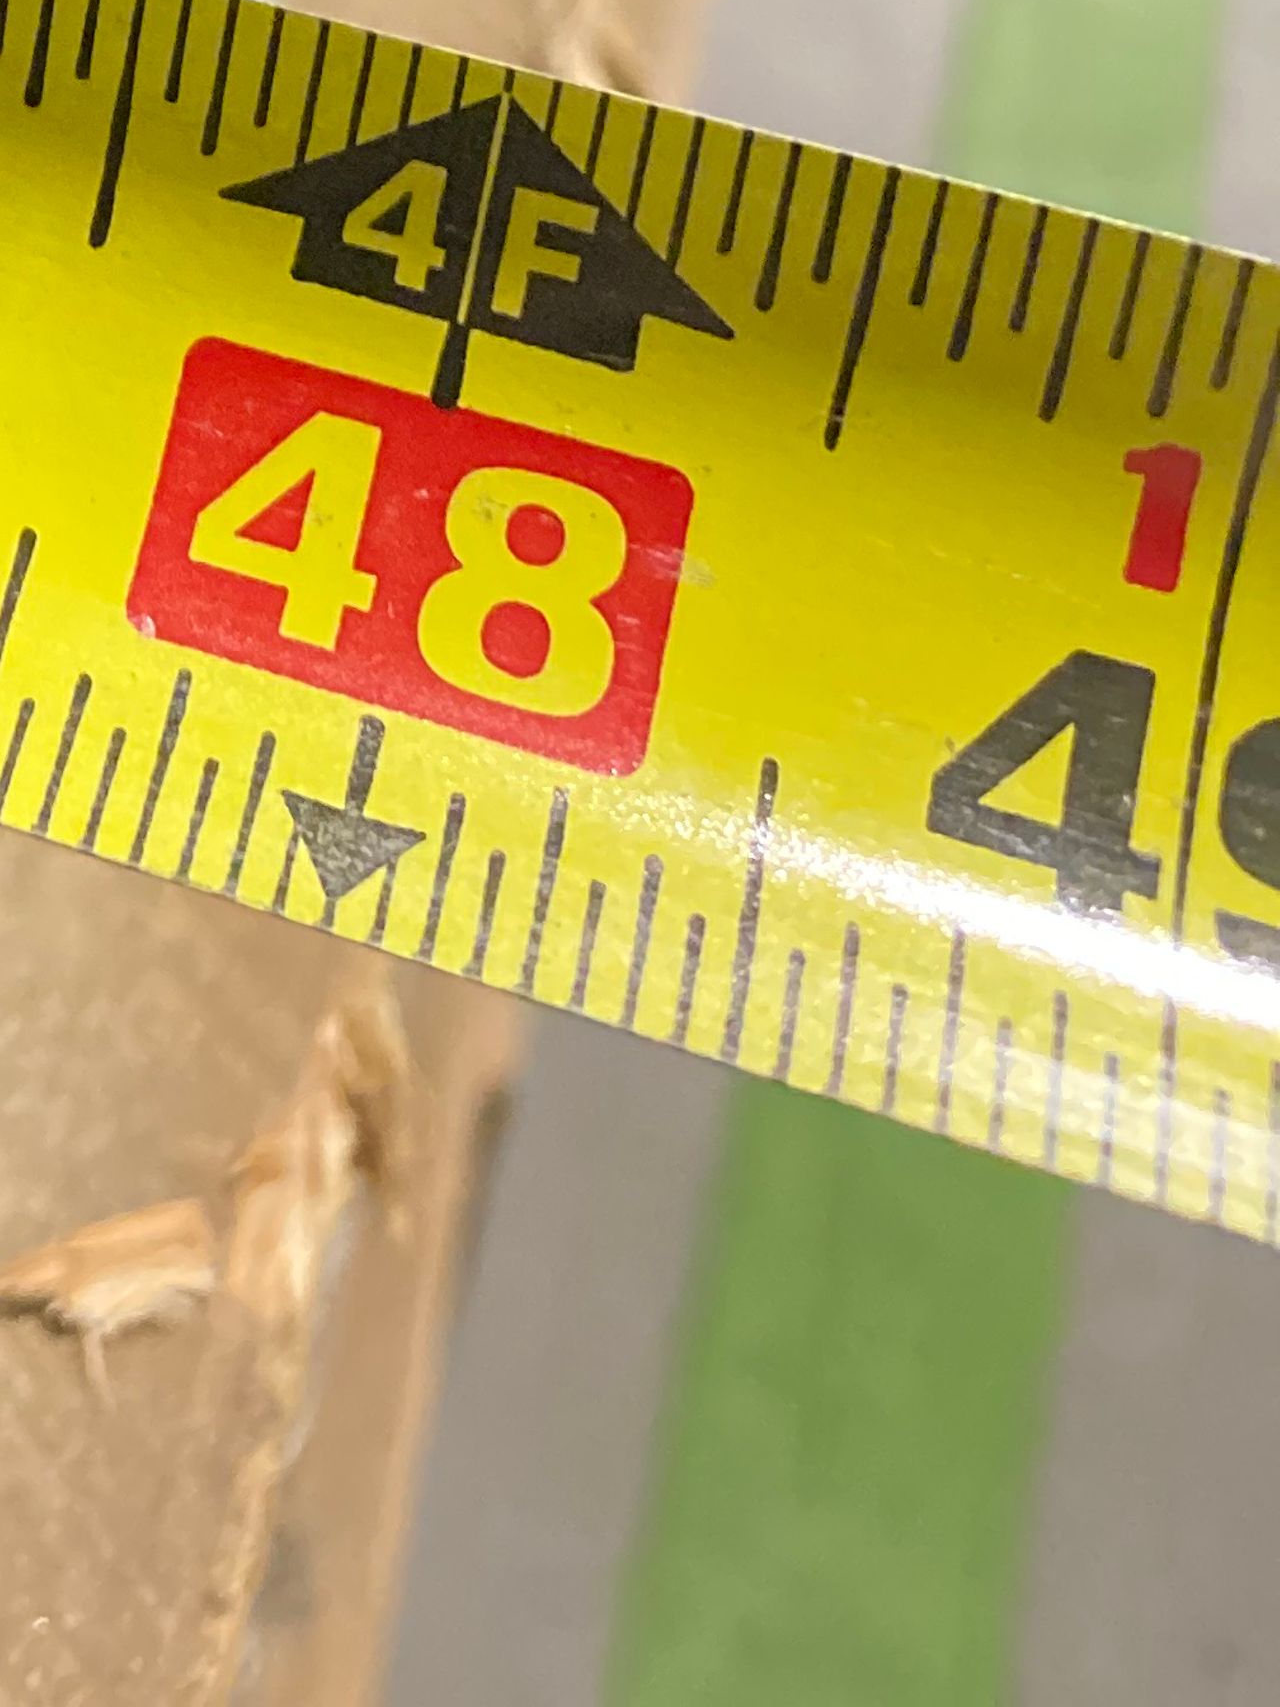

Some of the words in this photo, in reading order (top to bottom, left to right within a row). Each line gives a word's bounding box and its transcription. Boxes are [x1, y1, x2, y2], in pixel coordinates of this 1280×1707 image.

[341, 160, 597, 319] 4F
[186, 408, 630, 720] 48
[1122, 441, 1203, 593] 1
